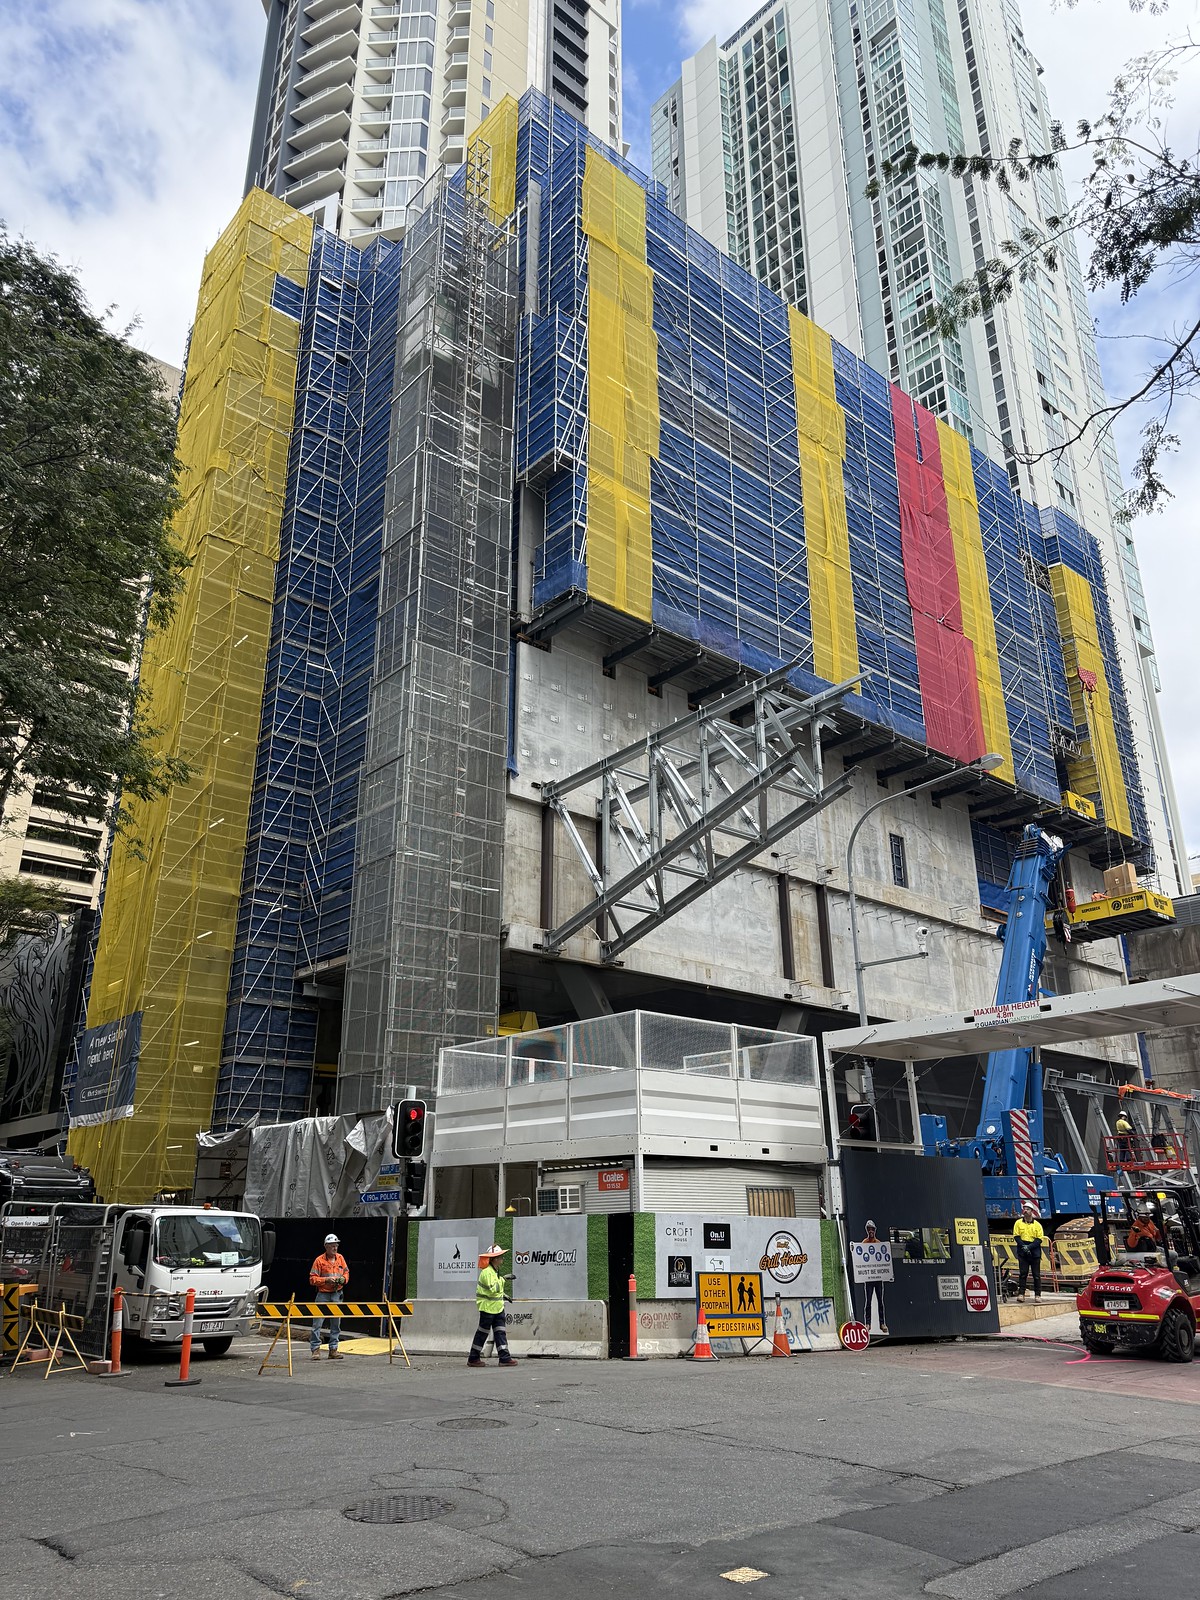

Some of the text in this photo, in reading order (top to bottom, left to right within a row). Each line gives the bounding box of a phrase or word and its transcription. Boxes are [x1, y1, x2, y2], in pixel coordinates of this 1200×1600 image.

[1122, 895, 1144, 903] PRESTON
[973, 1000, 1041, 1016] MAXIMUM HEIGHT
[996, 1011, 1014, 1019] 4.8m
[980, 1018, 1009, 1028] GUARDIAN
[89, 1037, 95, 1049] A
[95, 1036, 107, 1047] new
[602, 1172, 624, 1182] Coates
[380, 1192, 398, 1201] POLICE
[665, 1227, 693, 1236] CROFT
[531, 1249, 577, 1266] NightOwl
[759, 1251, 808, 1271] Grill House
[707, 1278, 721, 1286] USE
[703, 1289, 727, 1298] OTHER
[701, 1301, 730, 1310] FOOTPATH
[804, 1299, 832, 1310] TREE
[969, 1298, 987, 1306] ENTRY
[653, 1312, 682, 1321] ORANGE
[815, 1310, 830, 1326] PIT
[653, 1321, 669, 1330] HIRE
[717, 1322, 760, 1332] PEDESTRIANS
[844, 1328, 868, 1343] STOP
